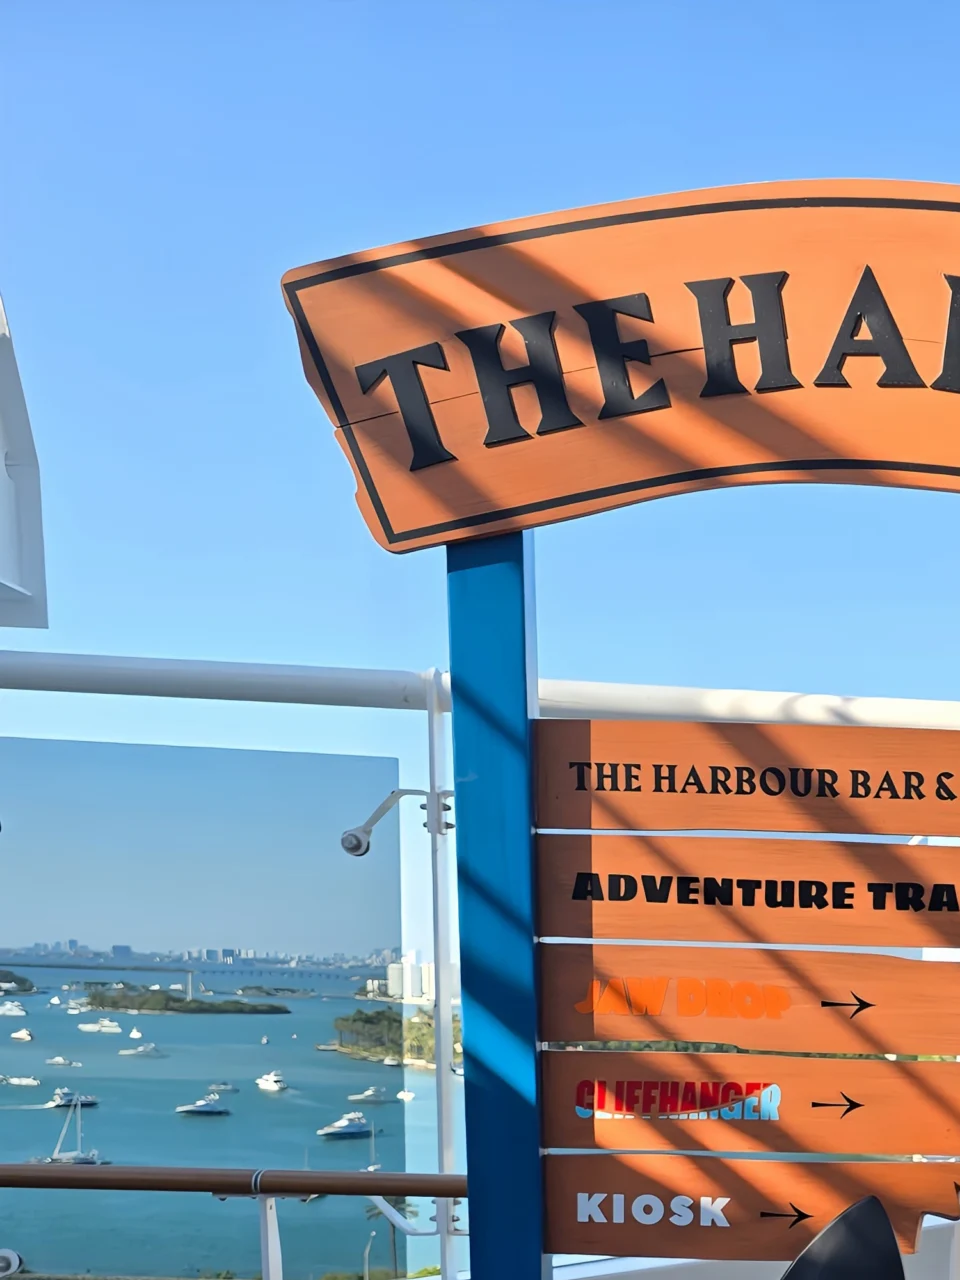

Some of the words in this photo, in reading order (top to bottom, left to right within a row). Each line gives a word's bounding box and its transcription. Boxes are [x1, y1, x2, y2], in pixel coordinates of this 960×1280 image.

[354, 292, 672, 472] THE
[569, 761, 642, 793] THE
[652, 764, 840, 798] HARBOUR
[849, 769, 926, 801] BAR
[935, 771, 958, 801] &
[571, 872, 855, 910] ADVENTURE
[574, 976, 673, 1016] JAW
[676, 977, 791, 1020] DROP
[574, 1079, 782, 1121] CLIFFHANGER
[575, 1191, 732, 1228] KIOSK
